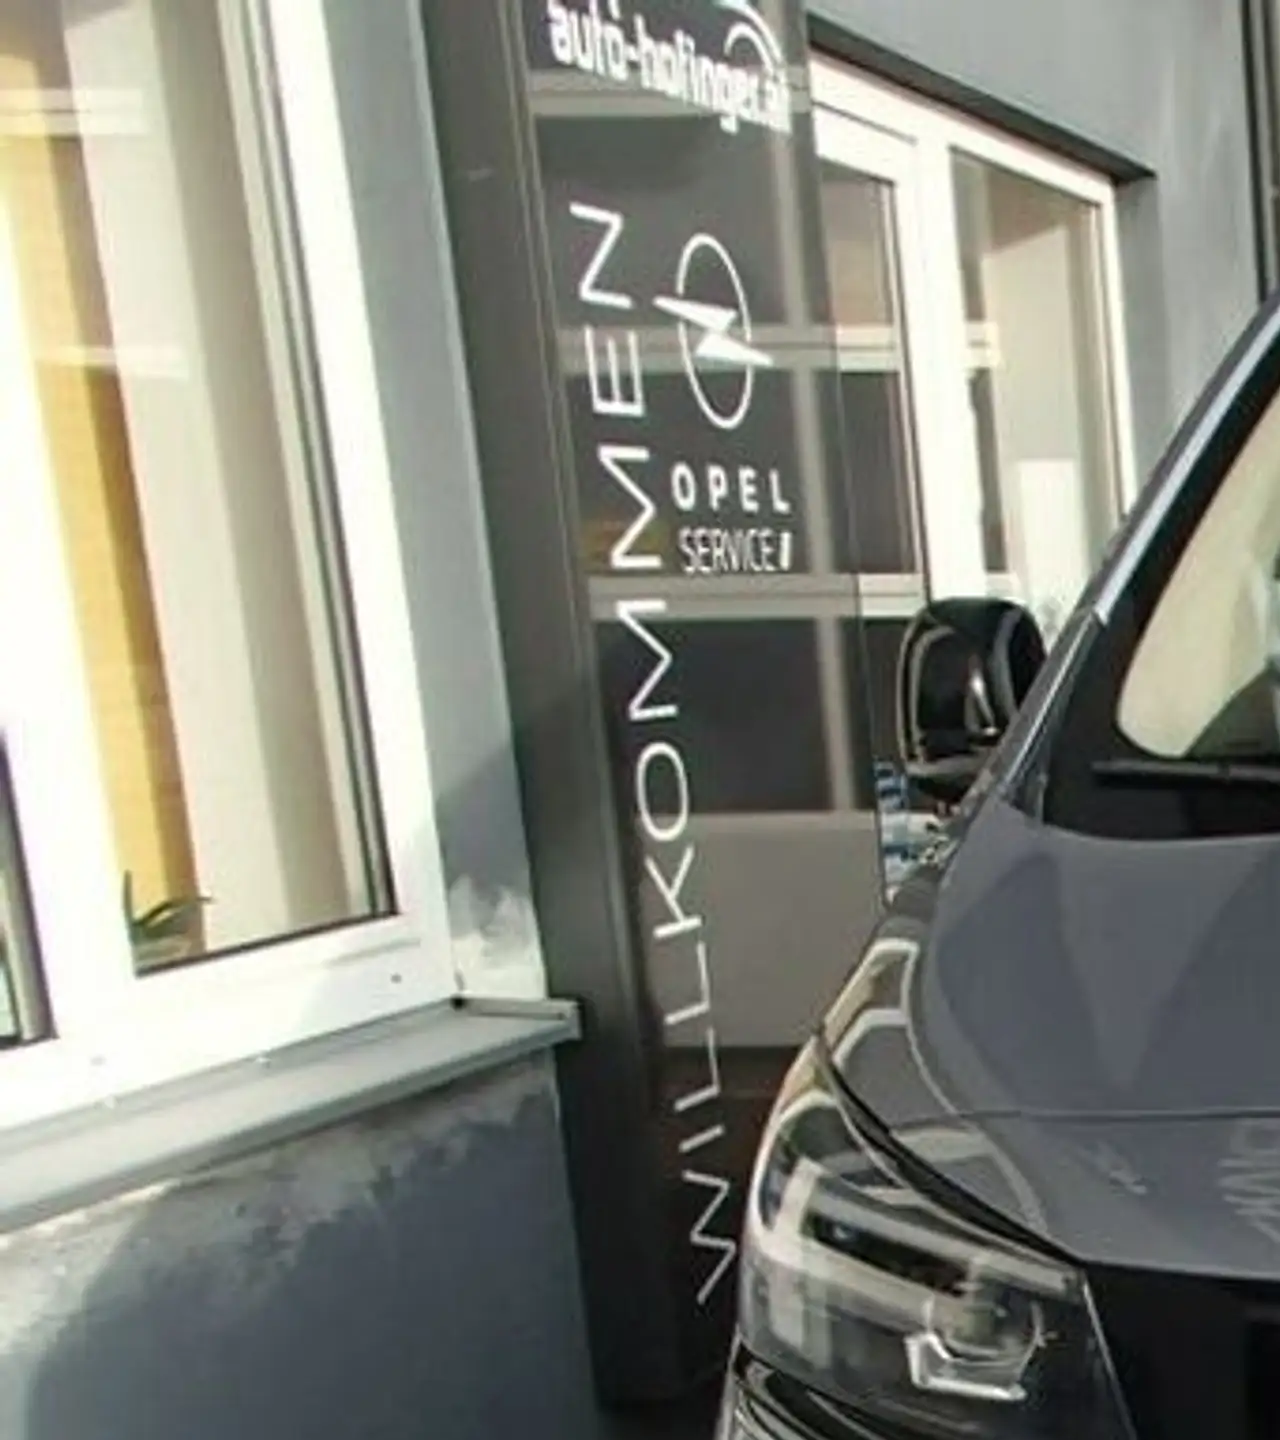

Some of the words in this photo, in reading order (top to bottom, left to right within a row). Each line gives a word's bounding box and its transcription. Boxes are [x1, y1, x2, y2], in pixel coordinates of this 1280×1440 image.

[671, 462, 791, 513] OPEL
[679, 527, 776, 574] SERVICE
[569, 202, 738, 1305] WILLKOMMEN
